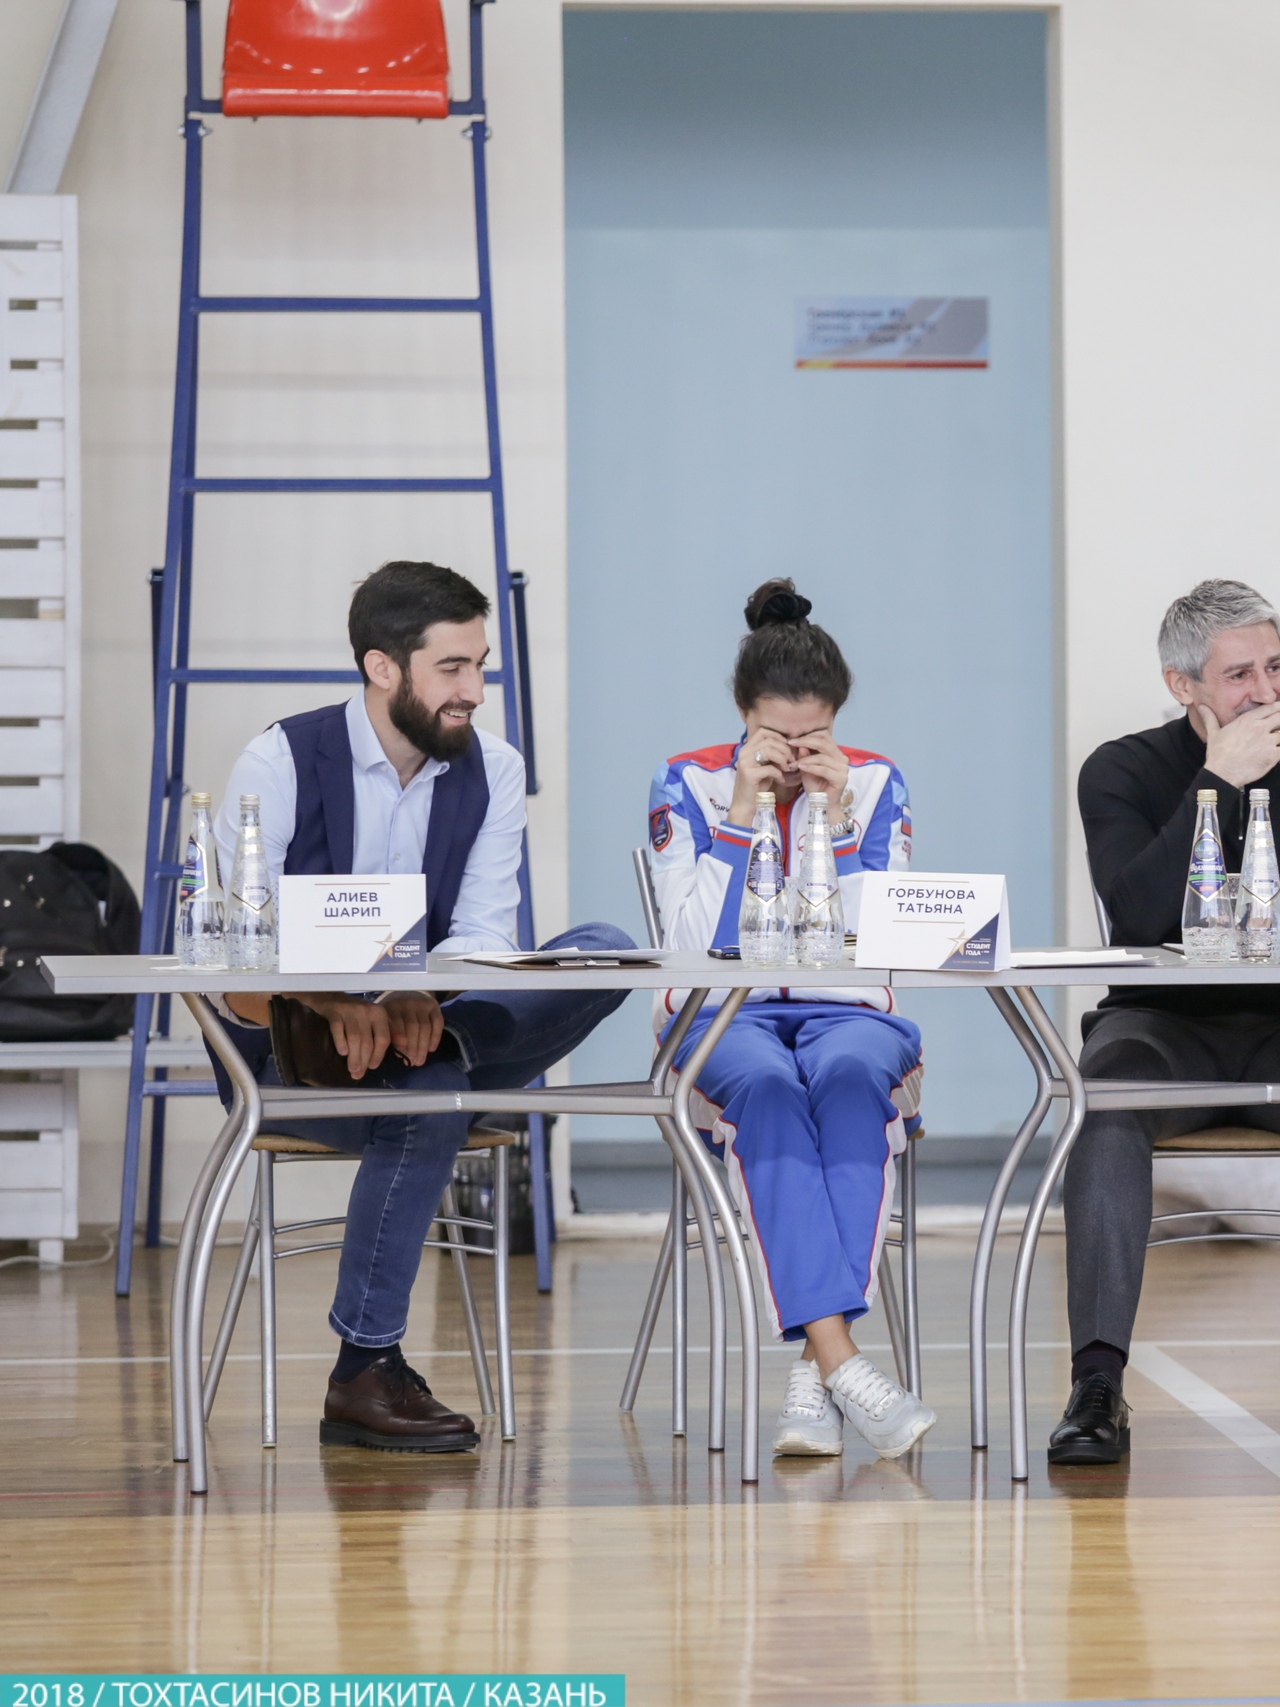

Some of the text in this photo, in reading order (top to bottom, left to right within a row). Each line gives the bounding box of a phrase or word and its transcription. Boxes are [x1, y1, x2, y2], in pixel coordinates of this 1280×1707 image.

[326, 892, 378, 902] АЛИЕВ
[887, 888, 976, 900] ГОРБУНОВА
[324, 907, 381, 917] ШАРИП
[897, 902, 963, 914] ТАТЬЯНА
